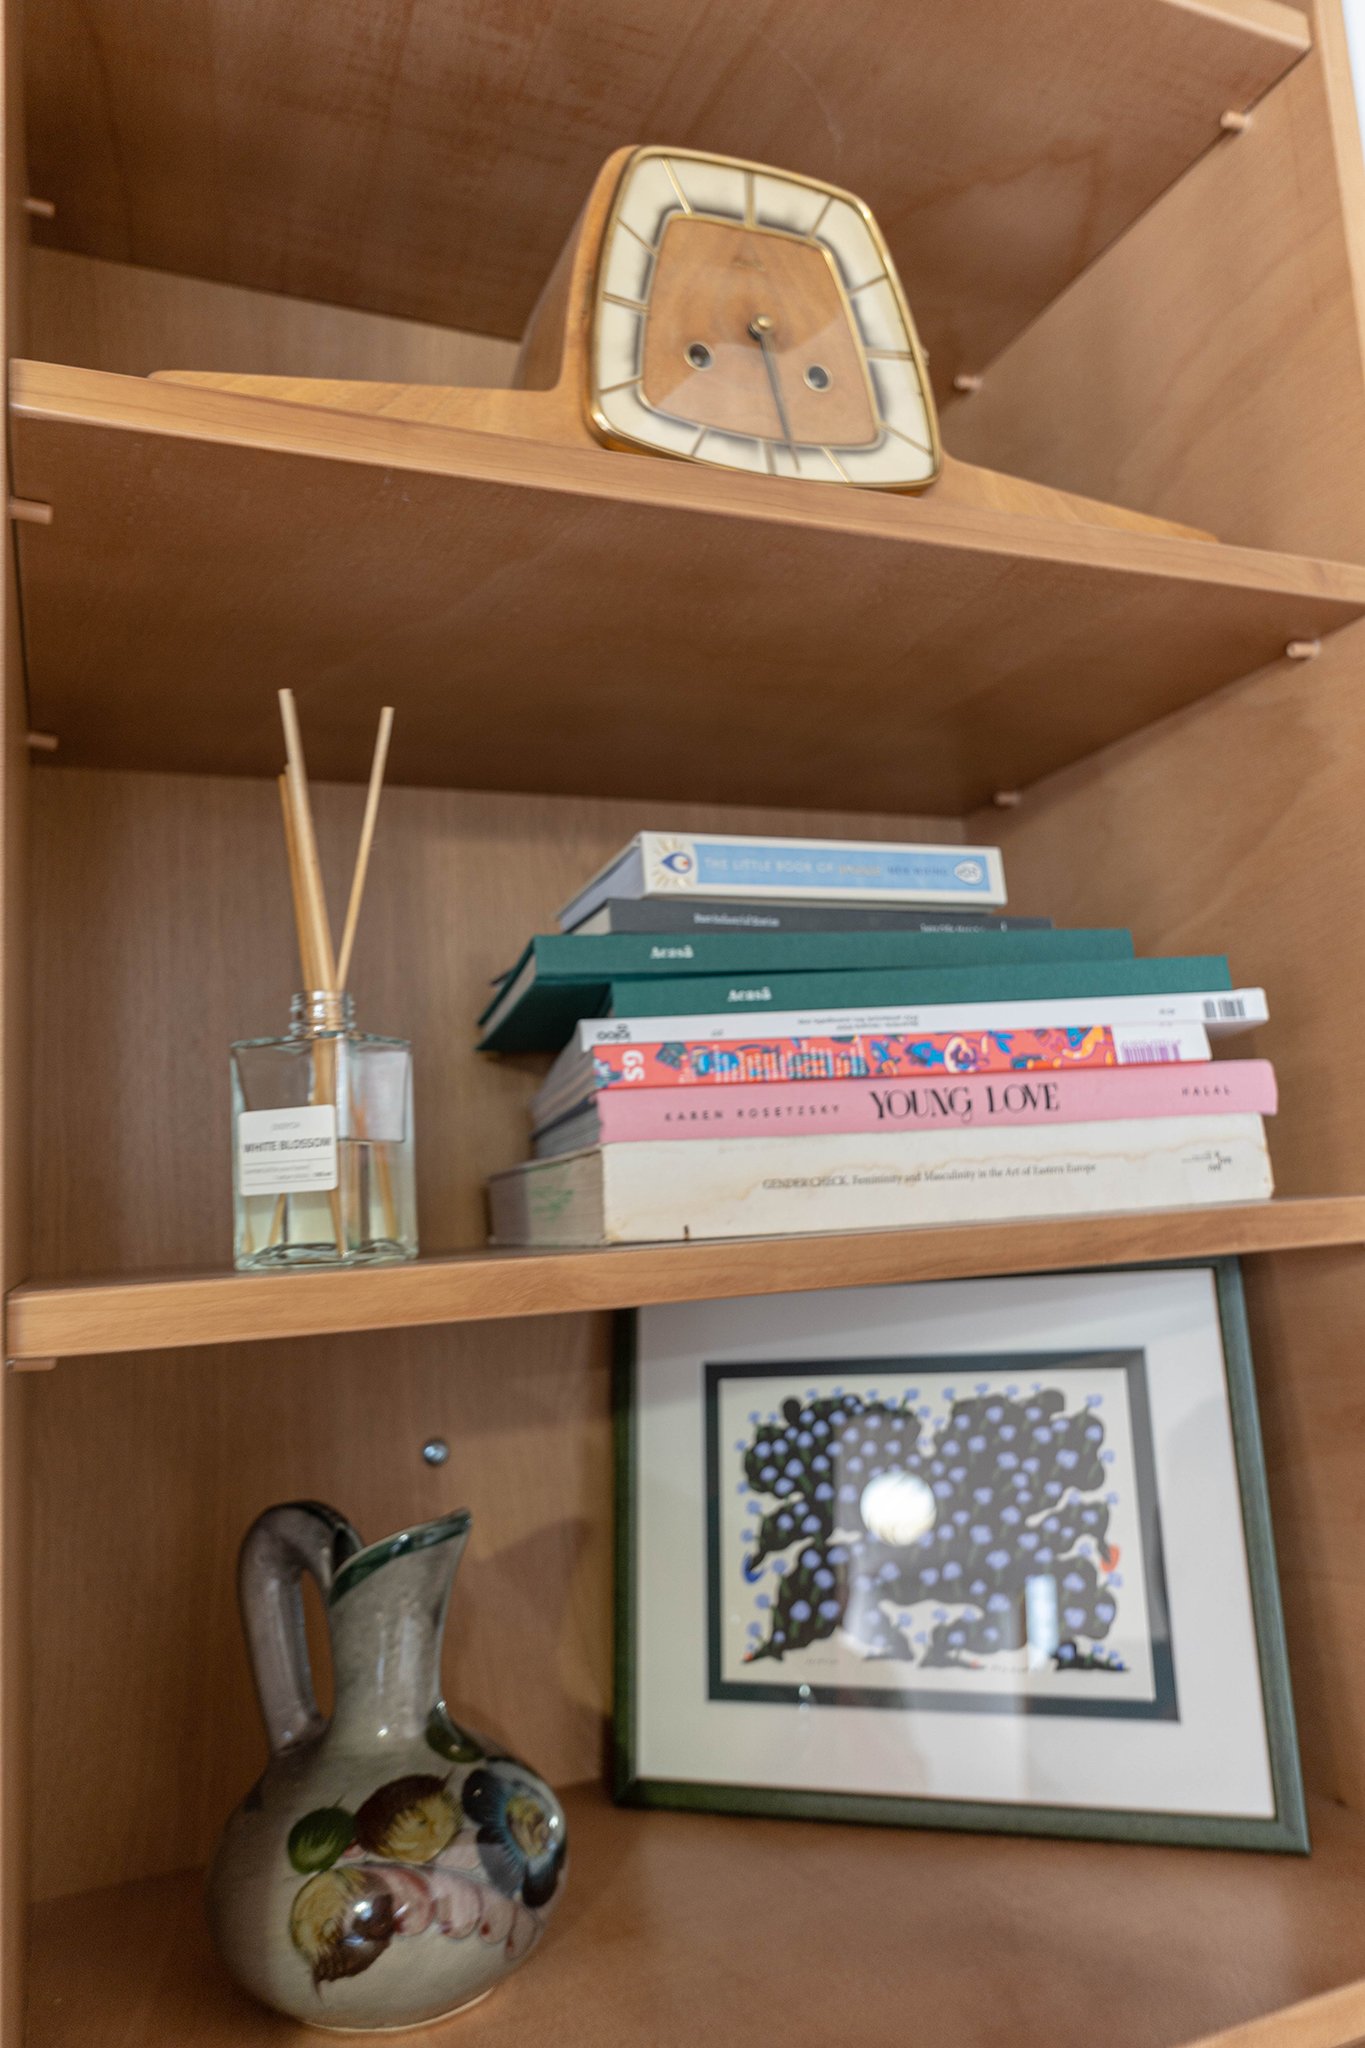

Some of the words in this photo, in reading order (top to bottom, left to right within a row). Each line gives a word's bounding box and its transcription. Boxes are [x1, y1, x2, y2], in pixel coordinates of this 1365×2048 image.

[704, 857, 728, 871] THE
[733, 858, 772, 873] LITTLE
[776, 860, 812, 873] BOOK
[816, 863, 833, 873] OF
[1182, 1085, 1232, 1097] HALAL
[869, 1086, 972, 1121] YOUNG
[986, 1082, 1060, 1114] LOVE
[664, 1110, 724, 1122] KAREN
[737, 1105, 840, 1119] ROSETZSKY
[244, 1141, 277, 1153] WHITE
[280, 1137, 332, 1151] BLOSSOM
[762, 1177, 807, 1189] GENDER
[852, 1173, 902, 1185] Femininity
[904, 1171, 921, 1183] and
[924, 1168, 975, 1182] Masculinity
[978, 1168, 986, 1179] in
[988, 1166, 1001, 1178] the
[1005, 1166, 1021, 1177] Art
[1022, 1164, 1031, 1176] of
[1032, 1163, 1064, 1175] Eastern
[1066, 1162, 1096, 1176] Europe
